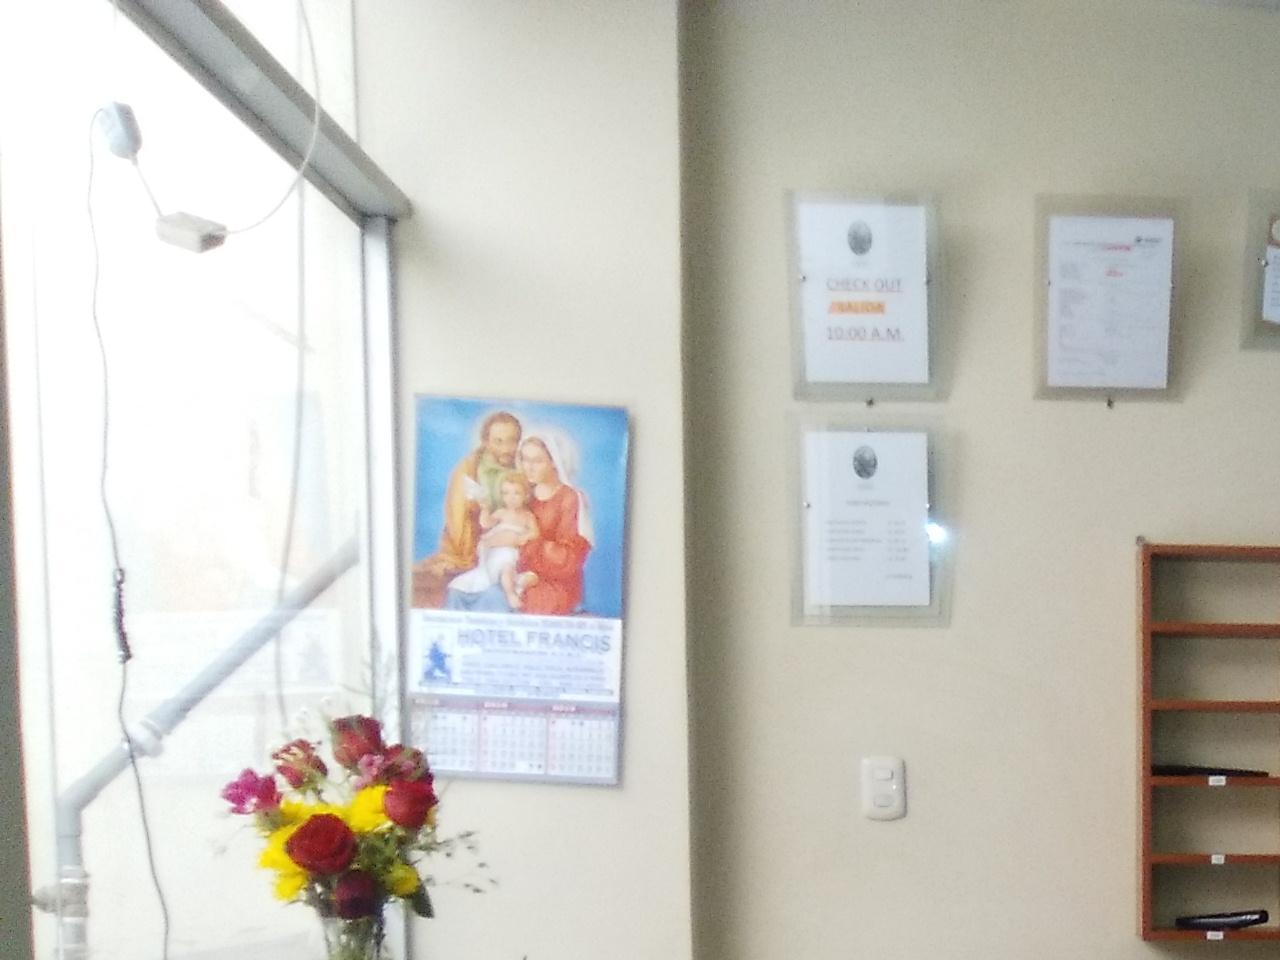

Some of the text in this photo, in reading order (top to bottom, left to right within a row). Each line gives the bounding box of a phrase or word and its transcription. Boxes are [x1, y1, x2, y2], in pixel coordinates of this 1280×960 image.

[826, 278, 902, 292] CHECK OUT
[827, 326, 866, 340] 10:00
[457, 629, 611, 653] HOTEL FRANCIS
